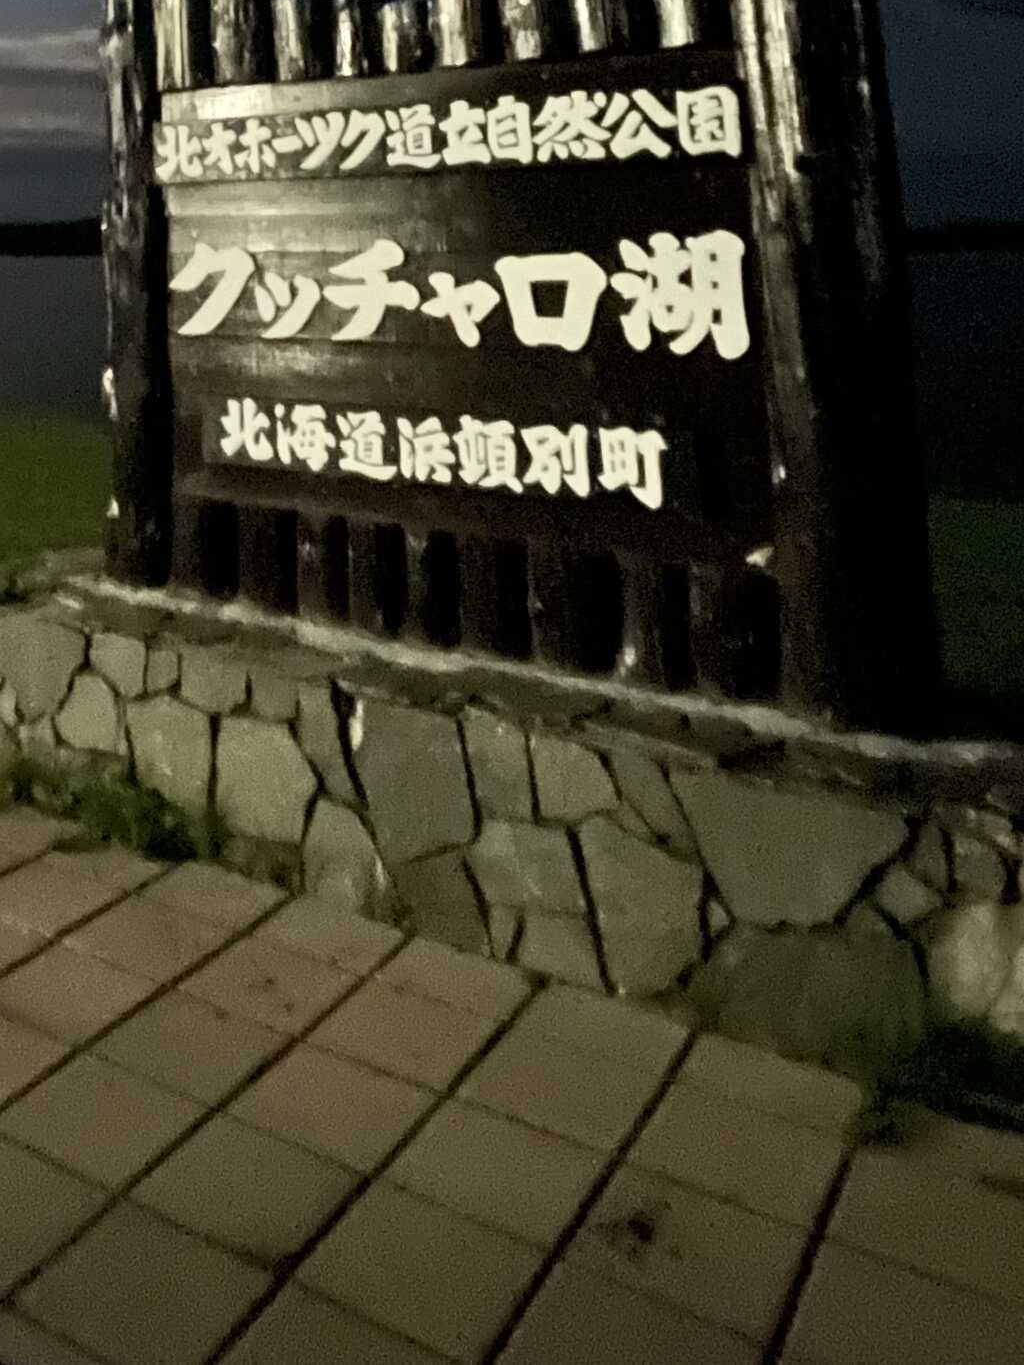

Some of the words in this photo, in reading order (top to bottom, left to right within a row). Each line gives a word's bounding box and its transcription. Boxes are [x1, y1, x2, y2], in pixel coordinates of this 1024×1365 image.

[155, 86, 742, 181] 北オホーツク道立自然公園
[169, 230, 750, 360] クッチャロ湖
[220, 398, 667, 510] 北海道浜頓別町
